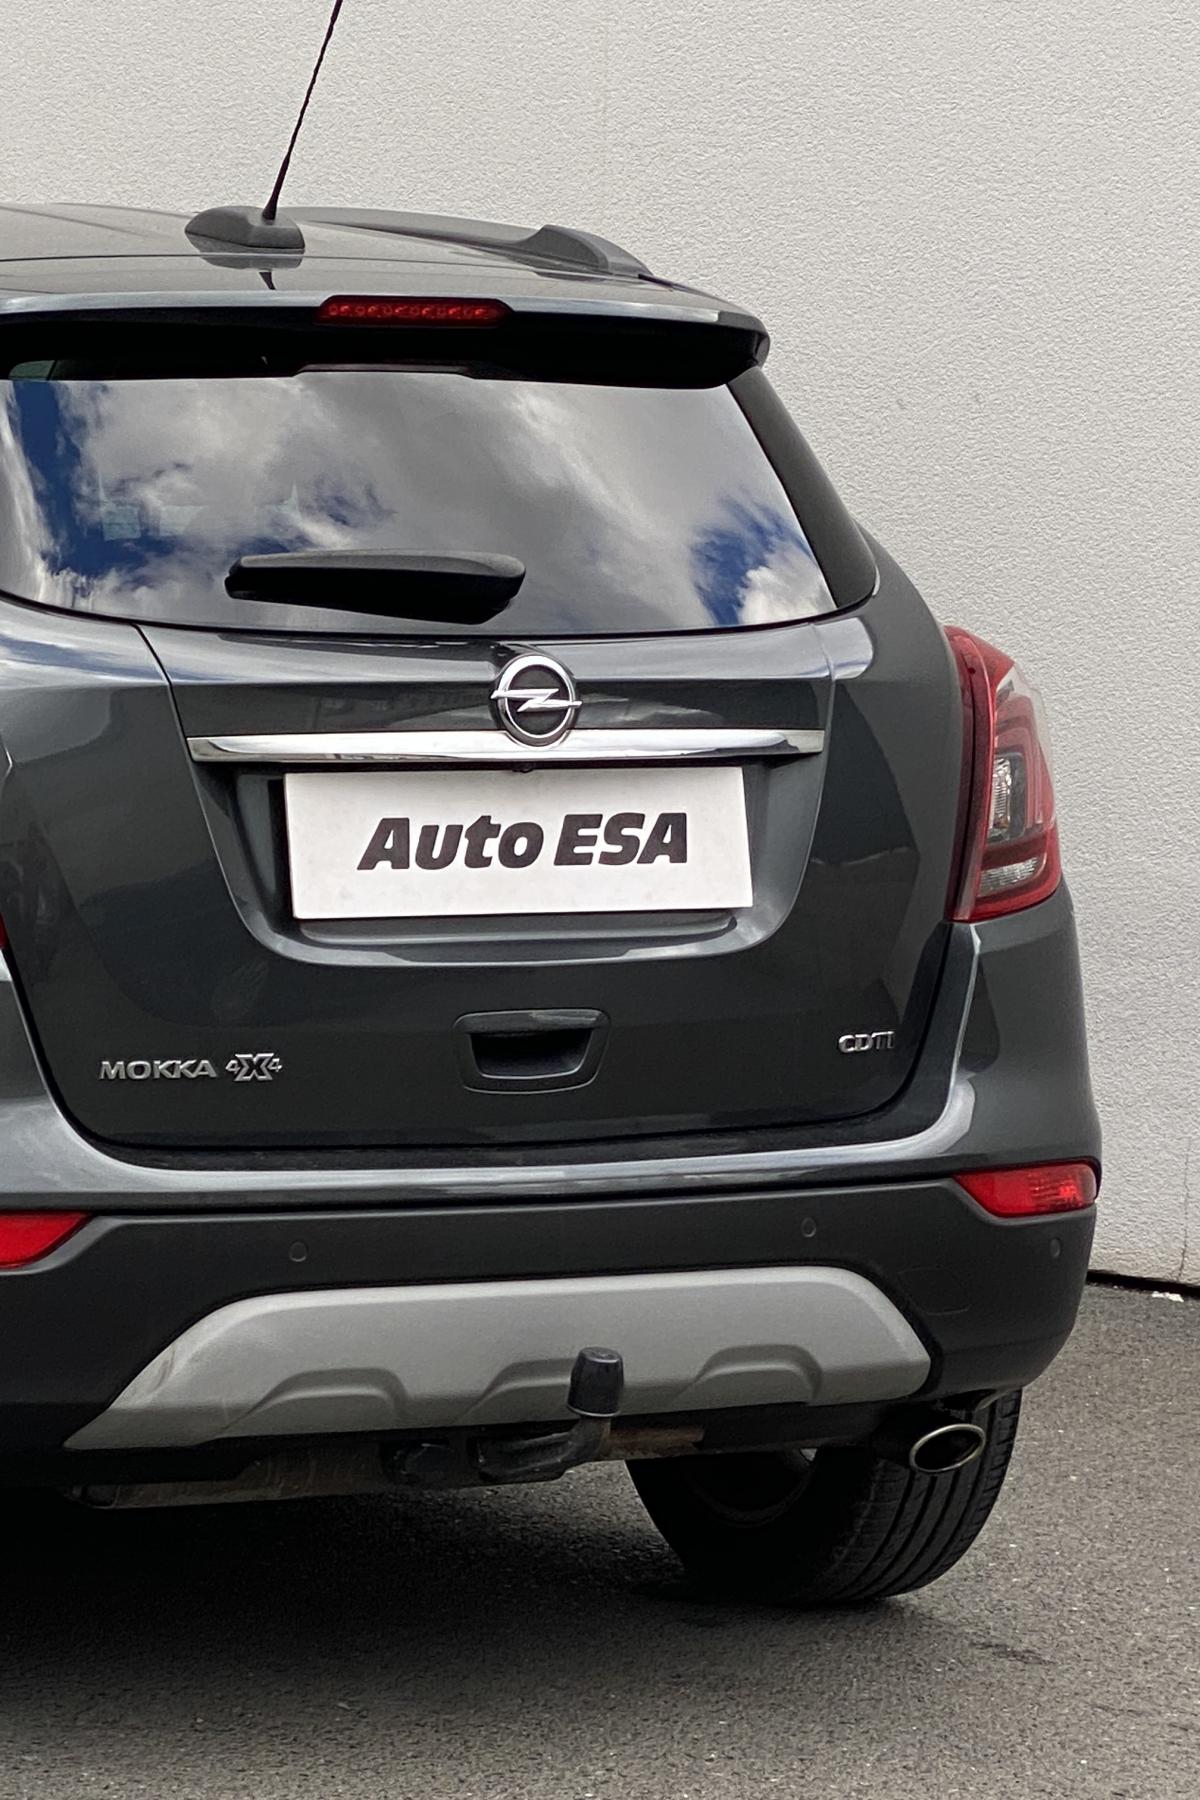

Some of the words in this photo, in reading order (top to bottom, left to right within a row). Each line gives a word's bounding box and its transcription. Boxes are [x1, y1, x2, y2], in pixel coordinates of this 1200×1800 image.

[356, 815, 544, 871] Auto
[553, 812, 688, 866] ESA
[99, 1059, 218, 1080] MOKKA
